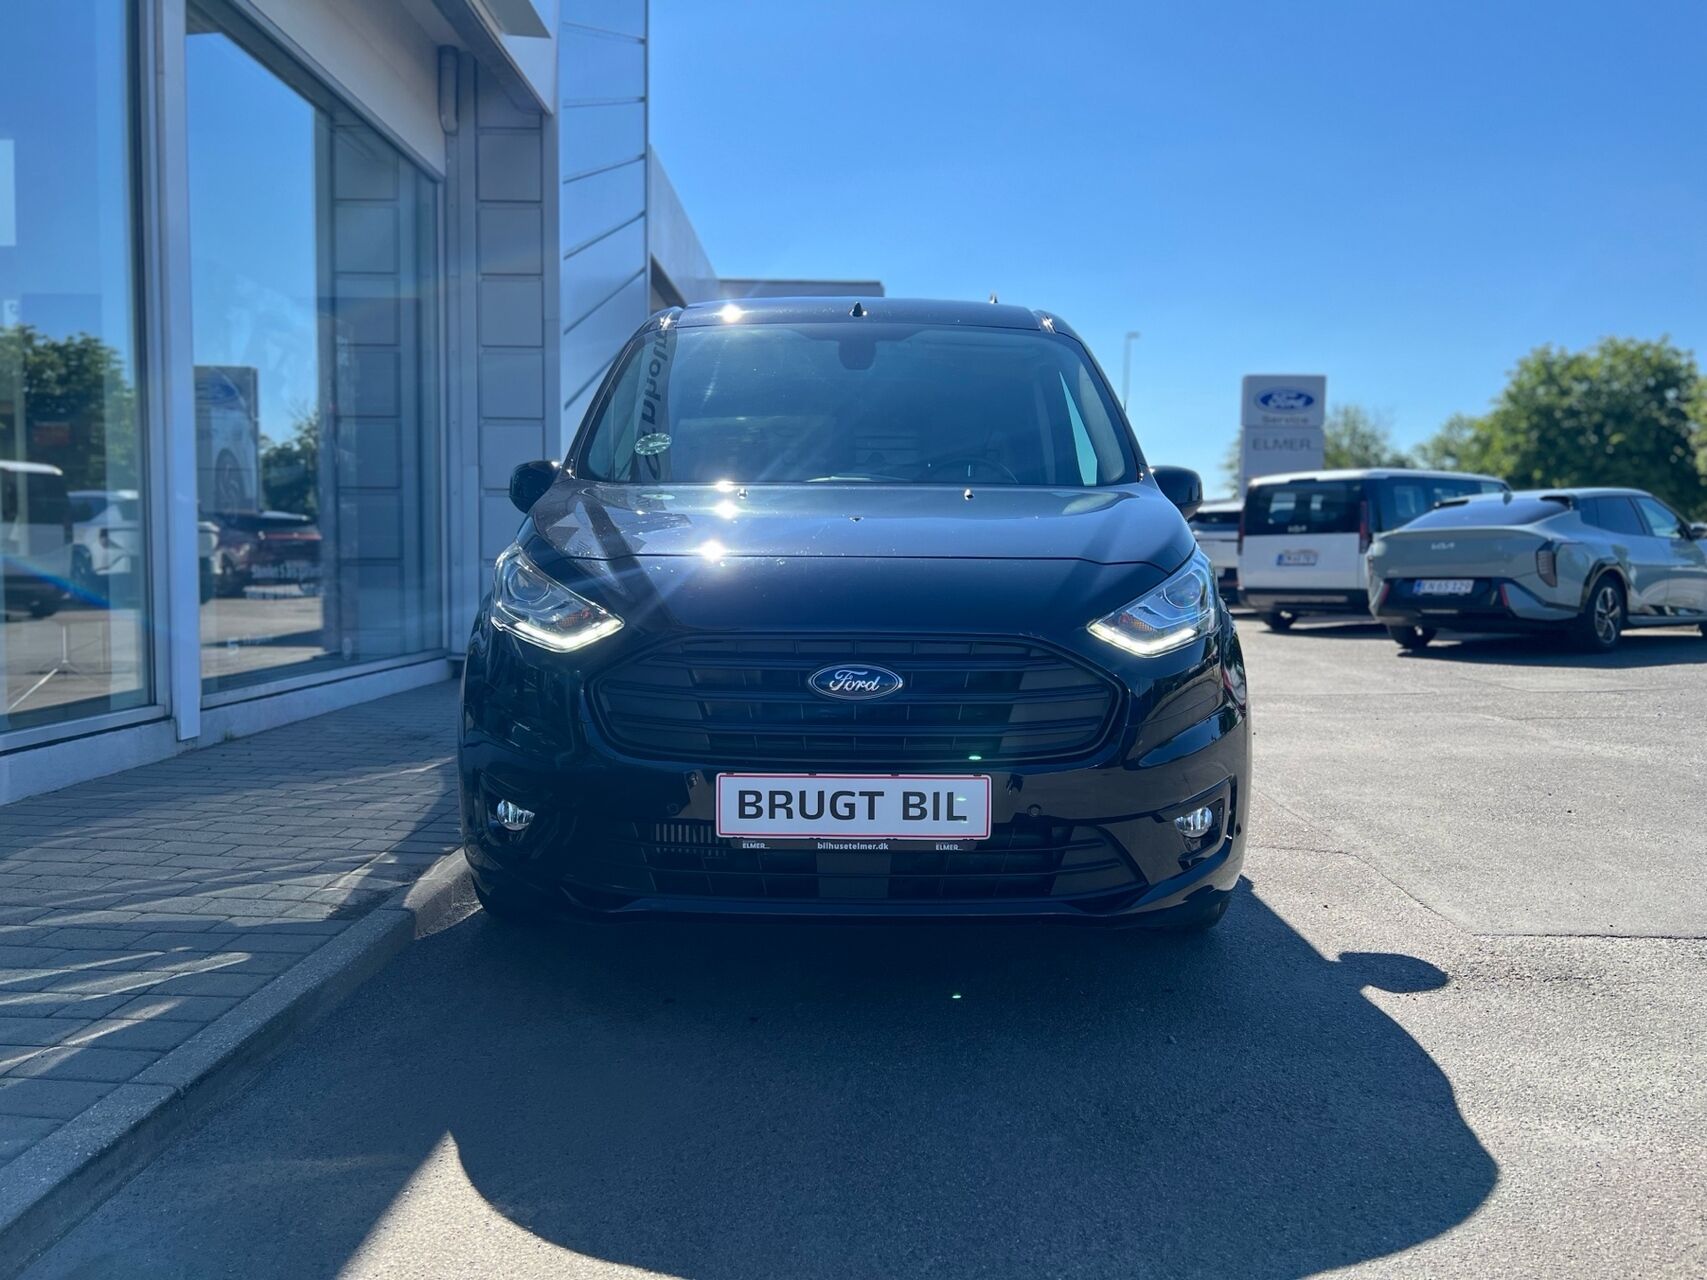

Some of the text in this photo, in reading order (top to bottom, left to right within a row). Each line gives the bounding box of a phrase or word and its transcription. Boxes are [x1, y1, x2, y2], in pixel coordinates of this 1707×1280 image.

[1252, 437, 1311, 452] ELMER
[829, 669, 881, 692] Ford
[737, 789, 968, 822] BRUGT BIL
[817, 841, 889, 851] bilhusetelmer.dk
